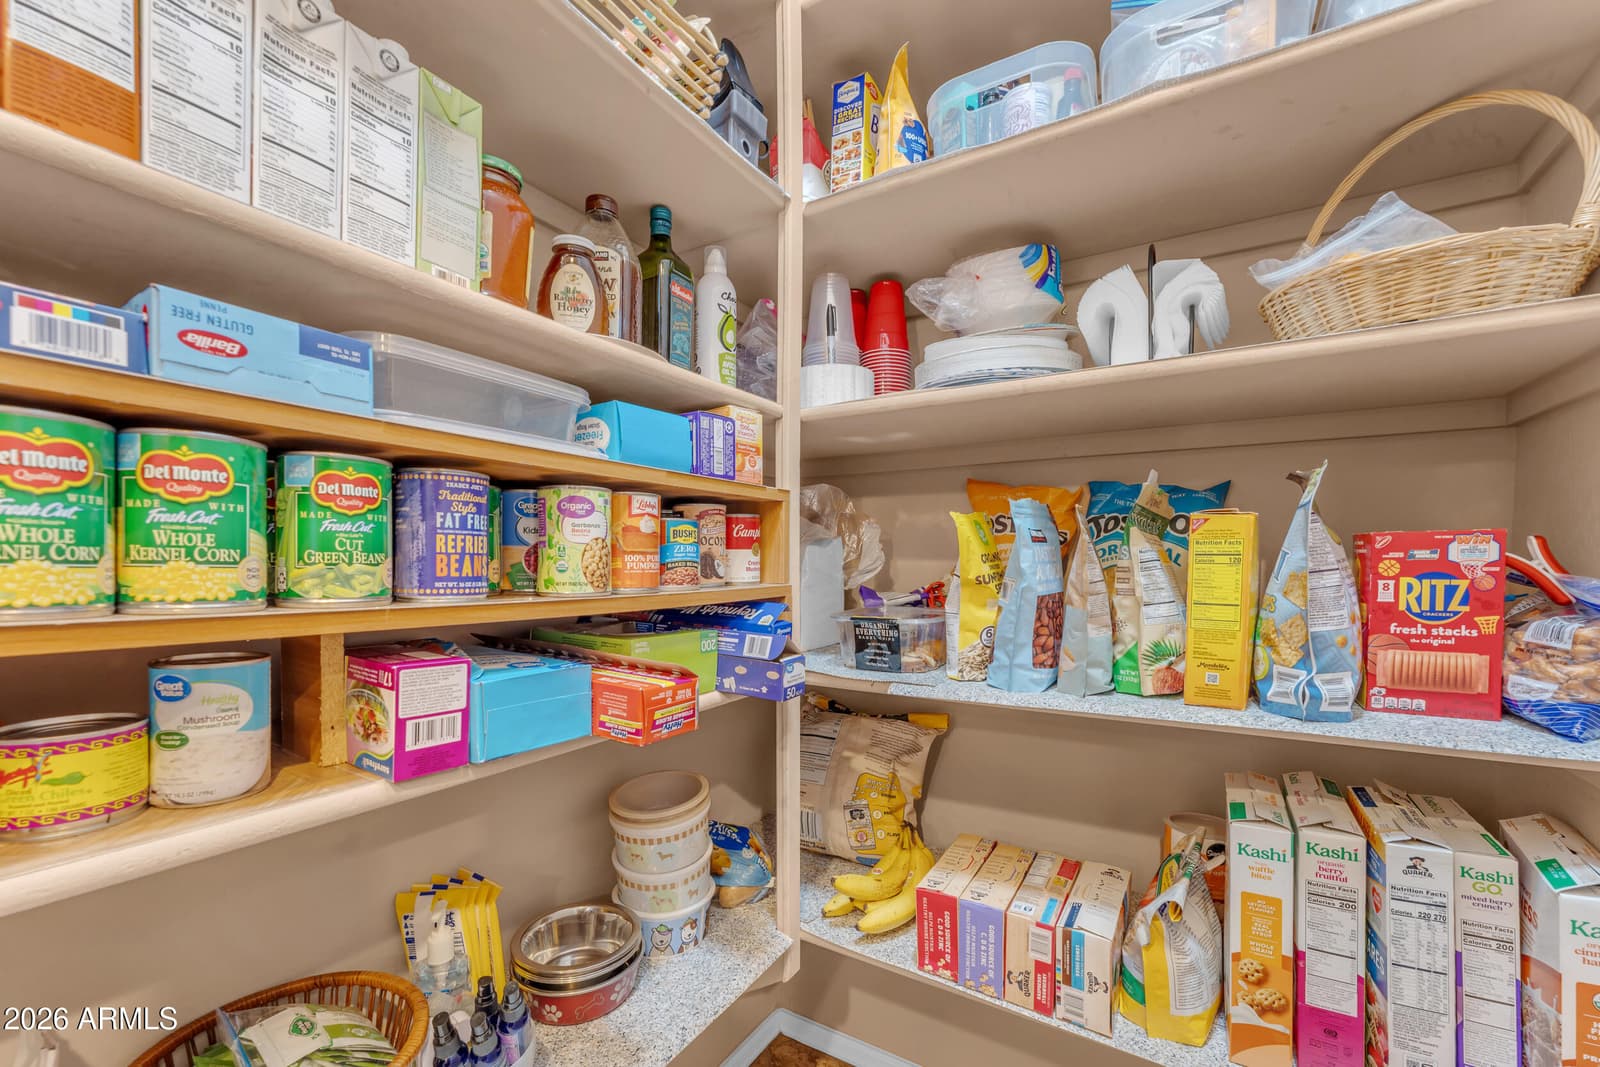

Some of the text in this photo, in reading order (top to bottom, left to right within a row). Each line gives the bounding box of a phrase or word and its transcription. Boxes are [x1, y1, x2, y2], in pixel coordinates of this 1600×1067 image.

[263, 32, 337, 79] Nutrition Facts
[262, 63, 294, 85] Calories
[324, 94, 337, 106] 10
[350, 82, 412, 122] Nutrition Facts
[350, 110, 377, 129] Calories
[401, 136, 412, 147] 10
[558, 302, 590, 316] Honey
[171, 304, 254, 336] GLUTEN FREE
[183, 332, 241, 356] Barilla
[22, 450, 88, 473] Monte
[144, 463, 229, 484] Del Monte
[166, 482, 204, 494] Quality
[317, 482, 378, 498] Del Monte
[66, 494, 104, 506] WITH
[336, 497, 364, 507] Quality
[438, 490, 488, 504] Traditional
[40, 502, 83, 519] Cut
[126, 498, 244, 512] MADE WITH
[450, 502, 478, 516] Style
[560, 502, 592, 511] Organic
[146, 507, 224, 525] Fresh Cut
[366, 514, 388, 522] WITH
[436, 512, 488, 530] FAT FREE
[320, 518, 377, 534] Fresh Cut
[0, 524, 76, 544] WHOLE
[152, 530, 216, 547] WHOLE
[672, 529, 698, 540] BUSH'S
[334, 538, 364, 551] CUT
[436, 534, 488, 554] REFRIED
[50, 544, 100, 560] CORN
[128, 544, 240, 562] KERNEL CORN
[304, 550, 386, 564] GREEN BEANS
[624, 554, 646, 562] 100%
[436, 554, 488, 577] BEANS
[1382, 582, 1390, 592] 8
[1398, 576, 1472, 614] RITZ
[855, 628, 898, 638] EVERYTHING
[1390, 622, 1478, 637] fresh stacks
[702, 639, 716, 652] 200
[1421, 637, 1456, 646] original
[155, 681, 184, 690] Great
[786, 687, 796, 700] 50
[183, 713, 240, 725] Mushroom
[662, 720, 684, 732] Hefty
[612, 730, 626, 738] Hefty
[1237, 842, 1287, 862] Kashi
[1306, 841, 1359, 862] Kashi
[1316, 872, 1348, 883] fruitful
[1318, 865, 1344, 876] berry
[1402, 868, 1434, 878] QUAKER
[1460, 866, 1514, 886] Kashi
[1307, 881, 1336, 890] Nutrition
[1390, 884, 1447, 898] Nutrition Facts
[1472, 882, 1503, 895] GO
[1307, 897, 1357, 910] Calories 200
[1460, 894, 1514, 908] mixed berry
[1472, 902, 1503, 912] crunch
[1390, 908, 1447, 922] Calories 220 270
[1462, 920, 1514, 934] Nutrition Facts
[1250, 941, 1274, 950] WHOLE
[1463, 938, 1514, 952] Calories 200
